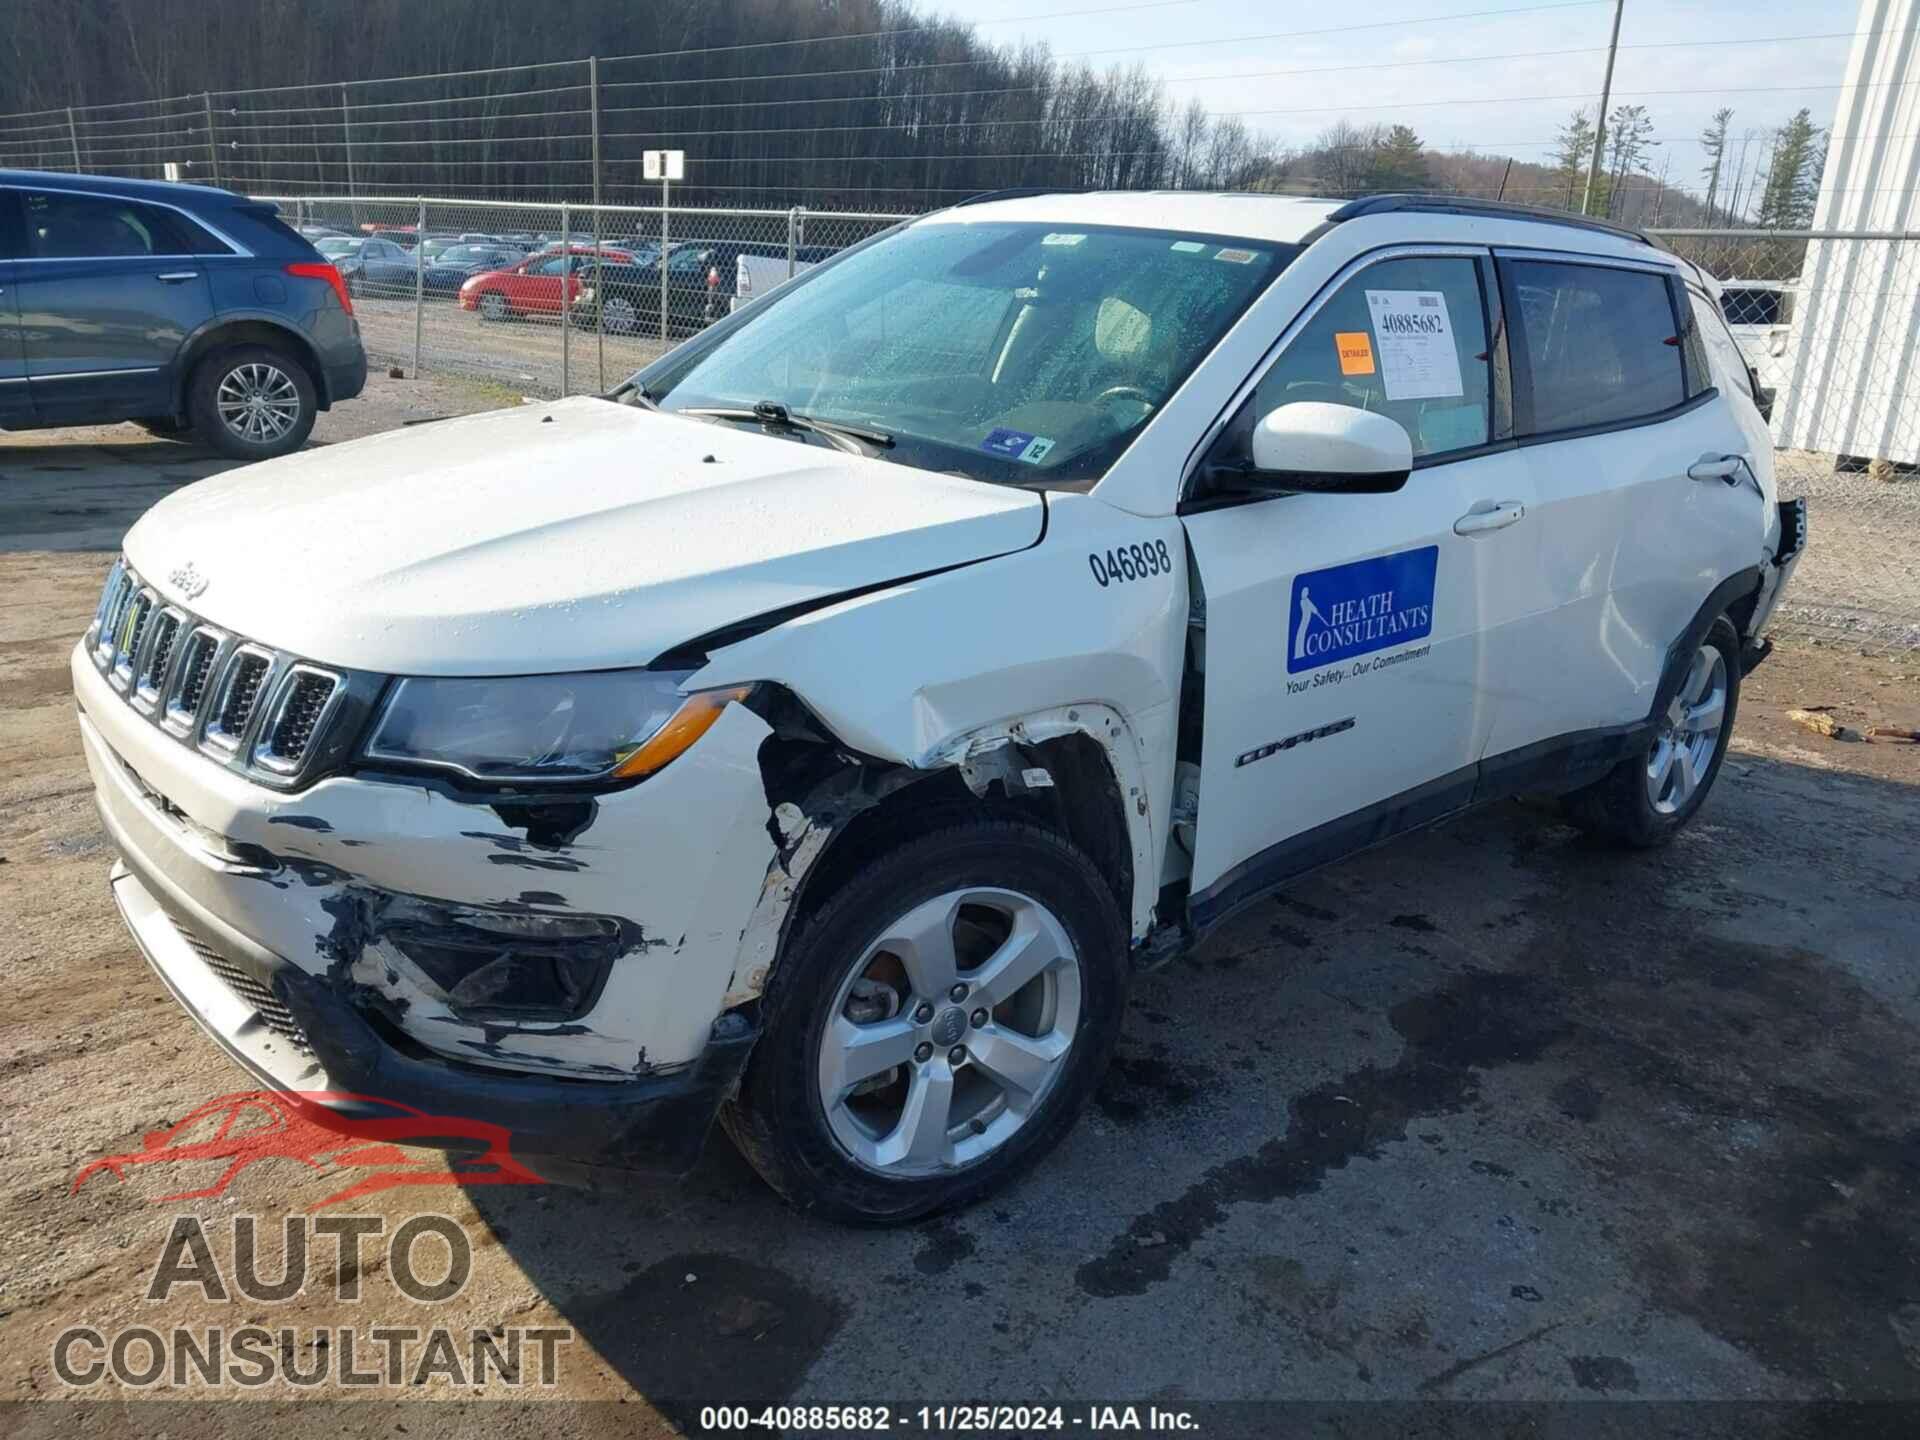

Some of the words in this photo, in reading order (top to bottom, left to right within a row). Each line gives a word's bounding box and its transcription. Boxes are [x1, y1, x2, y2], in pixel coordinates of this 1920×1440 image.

[1382, 313, 1444, 333] 40885682
[1029, 444, 1046, 458] 12
[1089, 539, 1172, 587] 046898
[1306, 604, 1430, 656] CONSULTANTS
[1331, 591, 1393, 627] HEATH
[1286, 678, 1311, 695] Your
[1373, 645, 1431, 671] Commitment
